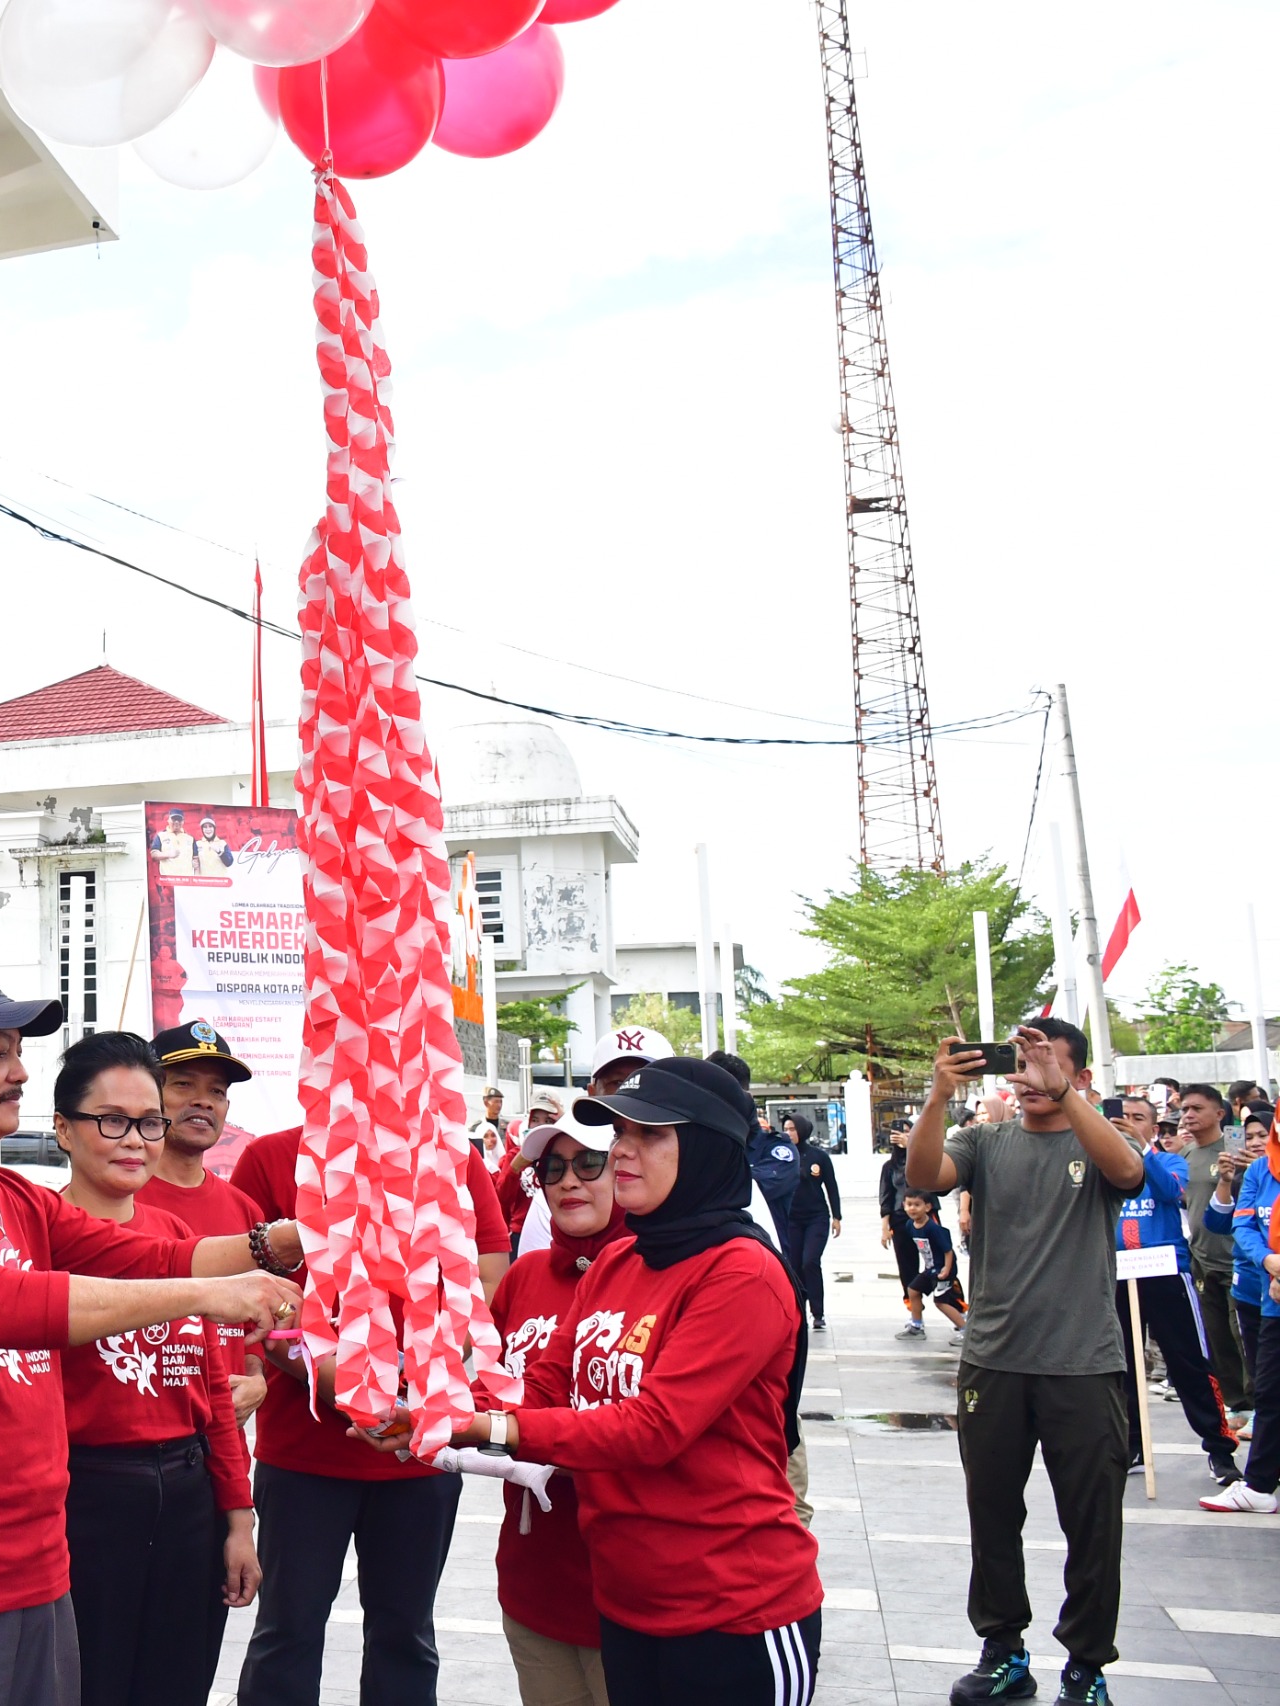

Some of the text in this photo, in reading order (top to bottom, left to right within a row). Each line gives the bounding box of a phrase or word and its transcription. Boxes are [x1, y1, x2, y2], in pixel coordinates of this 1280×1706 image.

[207, 951, 269, 964] REPUBLIK
[216, 983, 261, 993] DISPORA
[263, 984, 289, 994] KOTA
[162, 1355, 186, 1366] BARU
[28, 1361, 51, 1375] MAJU
